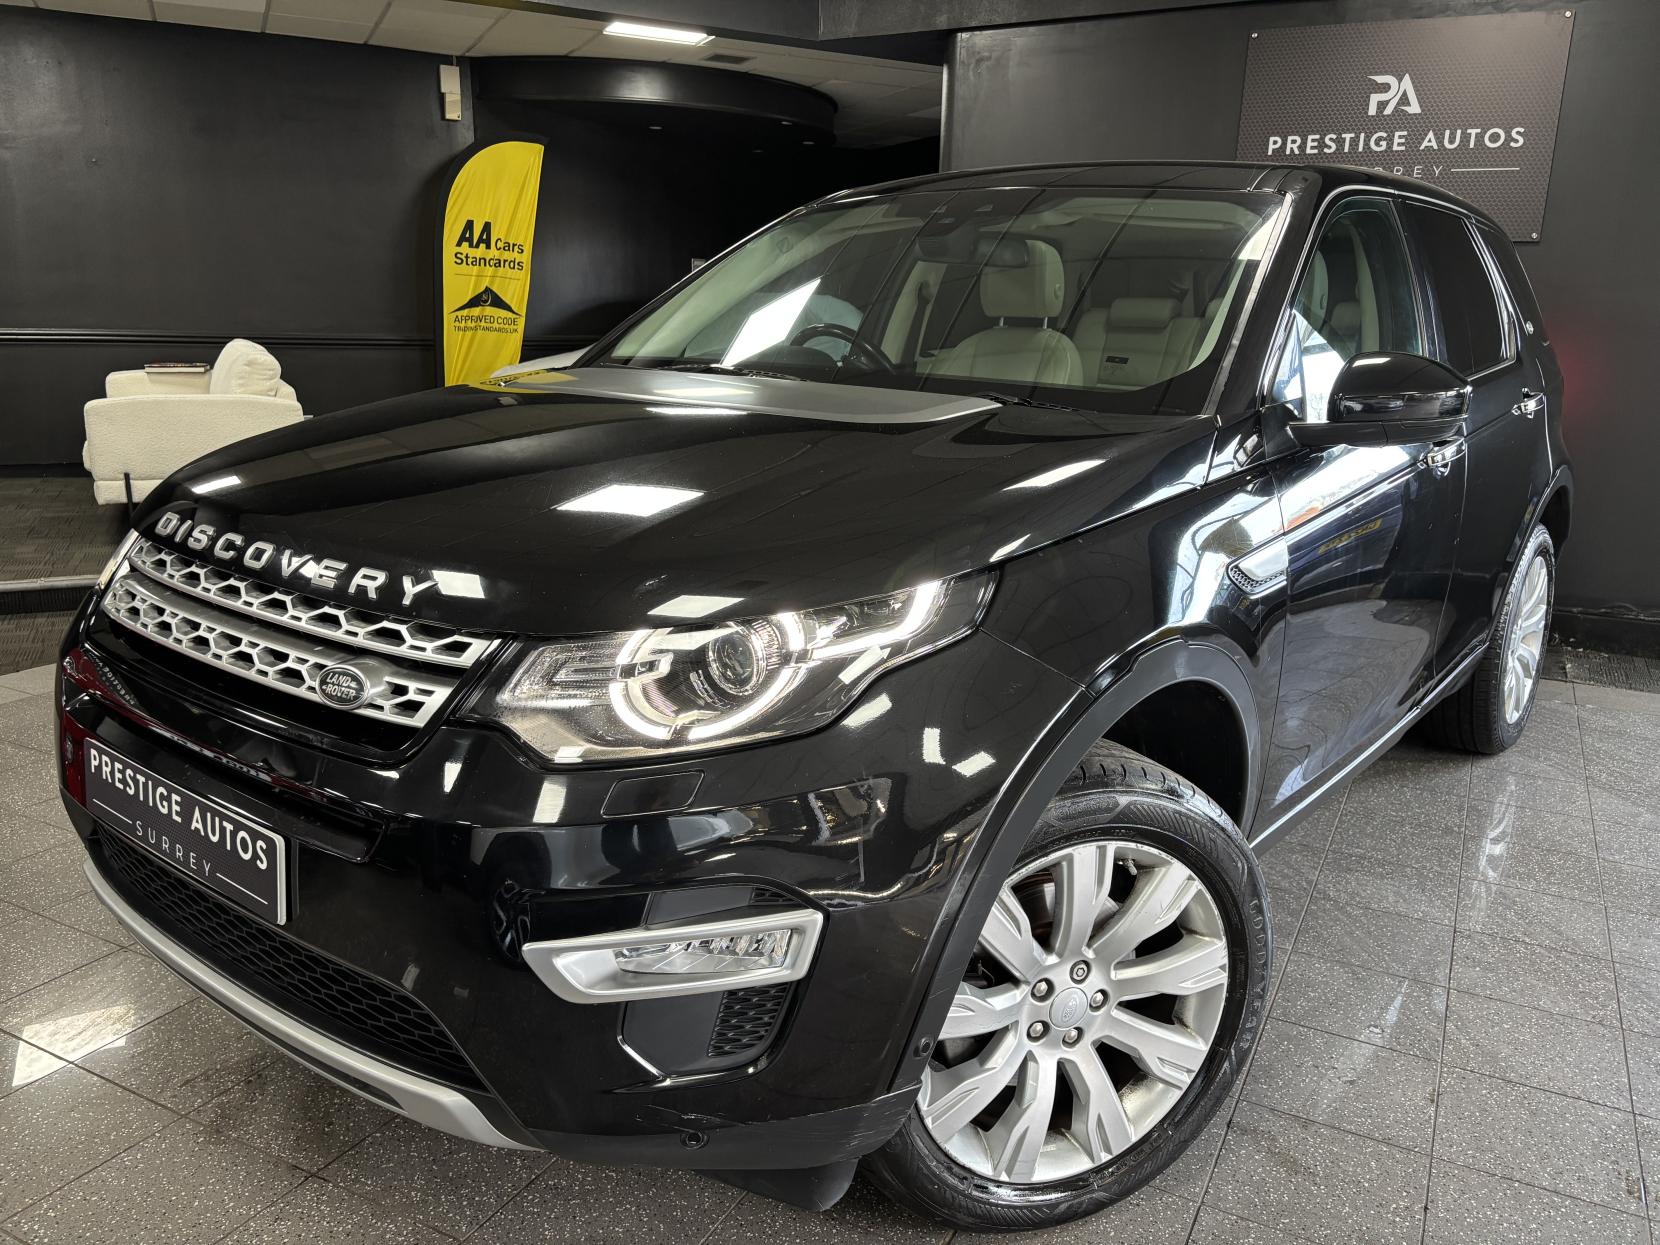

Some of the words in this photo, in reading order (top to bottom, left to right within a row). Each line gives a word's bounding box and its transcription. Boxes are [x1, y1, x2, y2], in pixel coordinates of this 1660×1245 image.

[1267, 130, 1408, 156] PRESTIGE
[1419, 127, 1525, 151] AUTOS
[455, 219, 492, 250] AA
[494, 238, 524, 254] Cars
[454, 252, 524, 271] Standards
[496, 316, 519, 326] CODE
[155, 512, 438, 606] DISCOVERY
[325, 684, 356, 700] ROVER
[326, 672, 352, 687] LAND
[90, 748, 182, 823] PRESTIGE
[191, 805, 268, 870] AUTOS
[135, 820, 212, 877] SURREY
